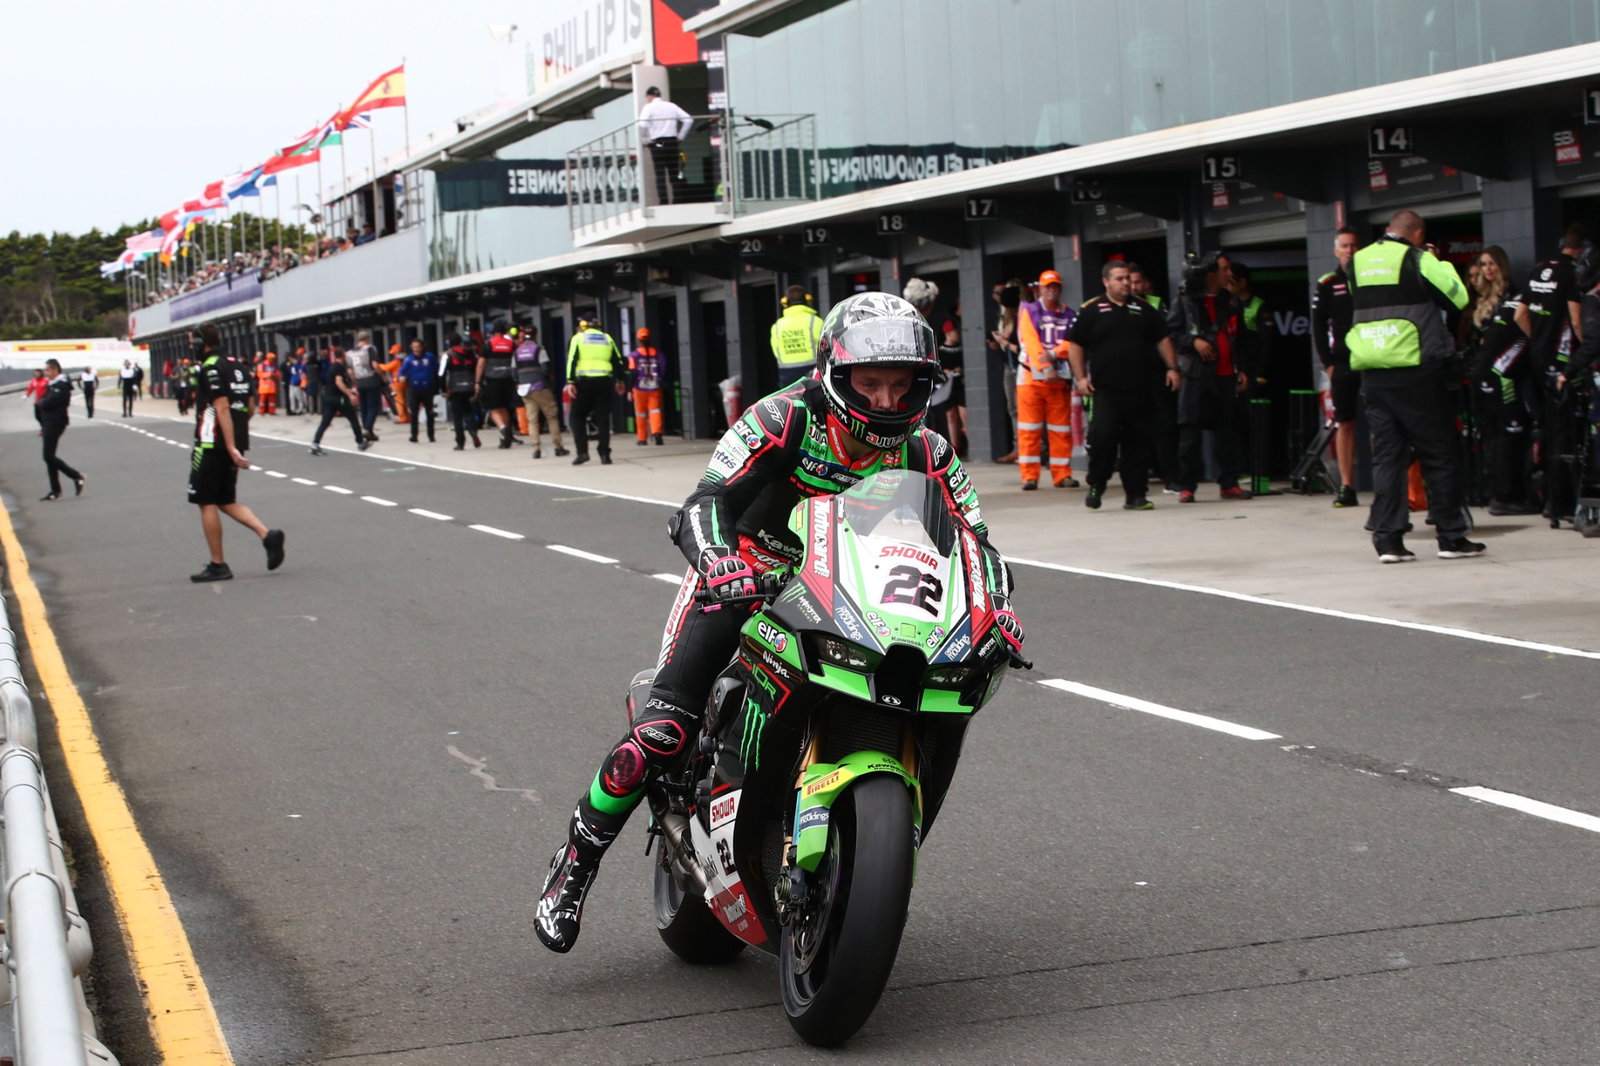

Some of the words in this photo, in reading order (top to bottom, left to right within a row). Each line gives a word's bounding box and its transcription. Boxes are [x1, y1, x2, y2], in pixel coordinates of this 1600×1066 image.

[543, 0, 615, 82] PHILLIP
[1373, 128, 1408, 150] 14
[1207, 158, 1236, 177] 15
[968, 200, 992, 216] 17
[880, 215, 903, 230] 18
[805, 228, 827, 243] 19
[741, 239, 762, 253] 20
[577, 269, 593, 281] 23
[616, 262, 633, 274] 22
[510, 281, 526, 292] 25
[1360, 325, 1400, 339] MEDIA
[879, 545, 939, 570] SHOWA
[880, 565, 944, 617] 22
[799, 595, 821, 624] MONSTER
[866, 611, 884, 632] elf
[757, 622, 778, 644] elf
[891, 635, 925, 648] Kawasaki
[926, 629, 941, 648] elf
[763, 651, 790, 678] Ninja
[640, 727, 680, 745] RST
[807, 771, 840, 796] PIRELLI
[712, 797, 735, 823] SHOWA
